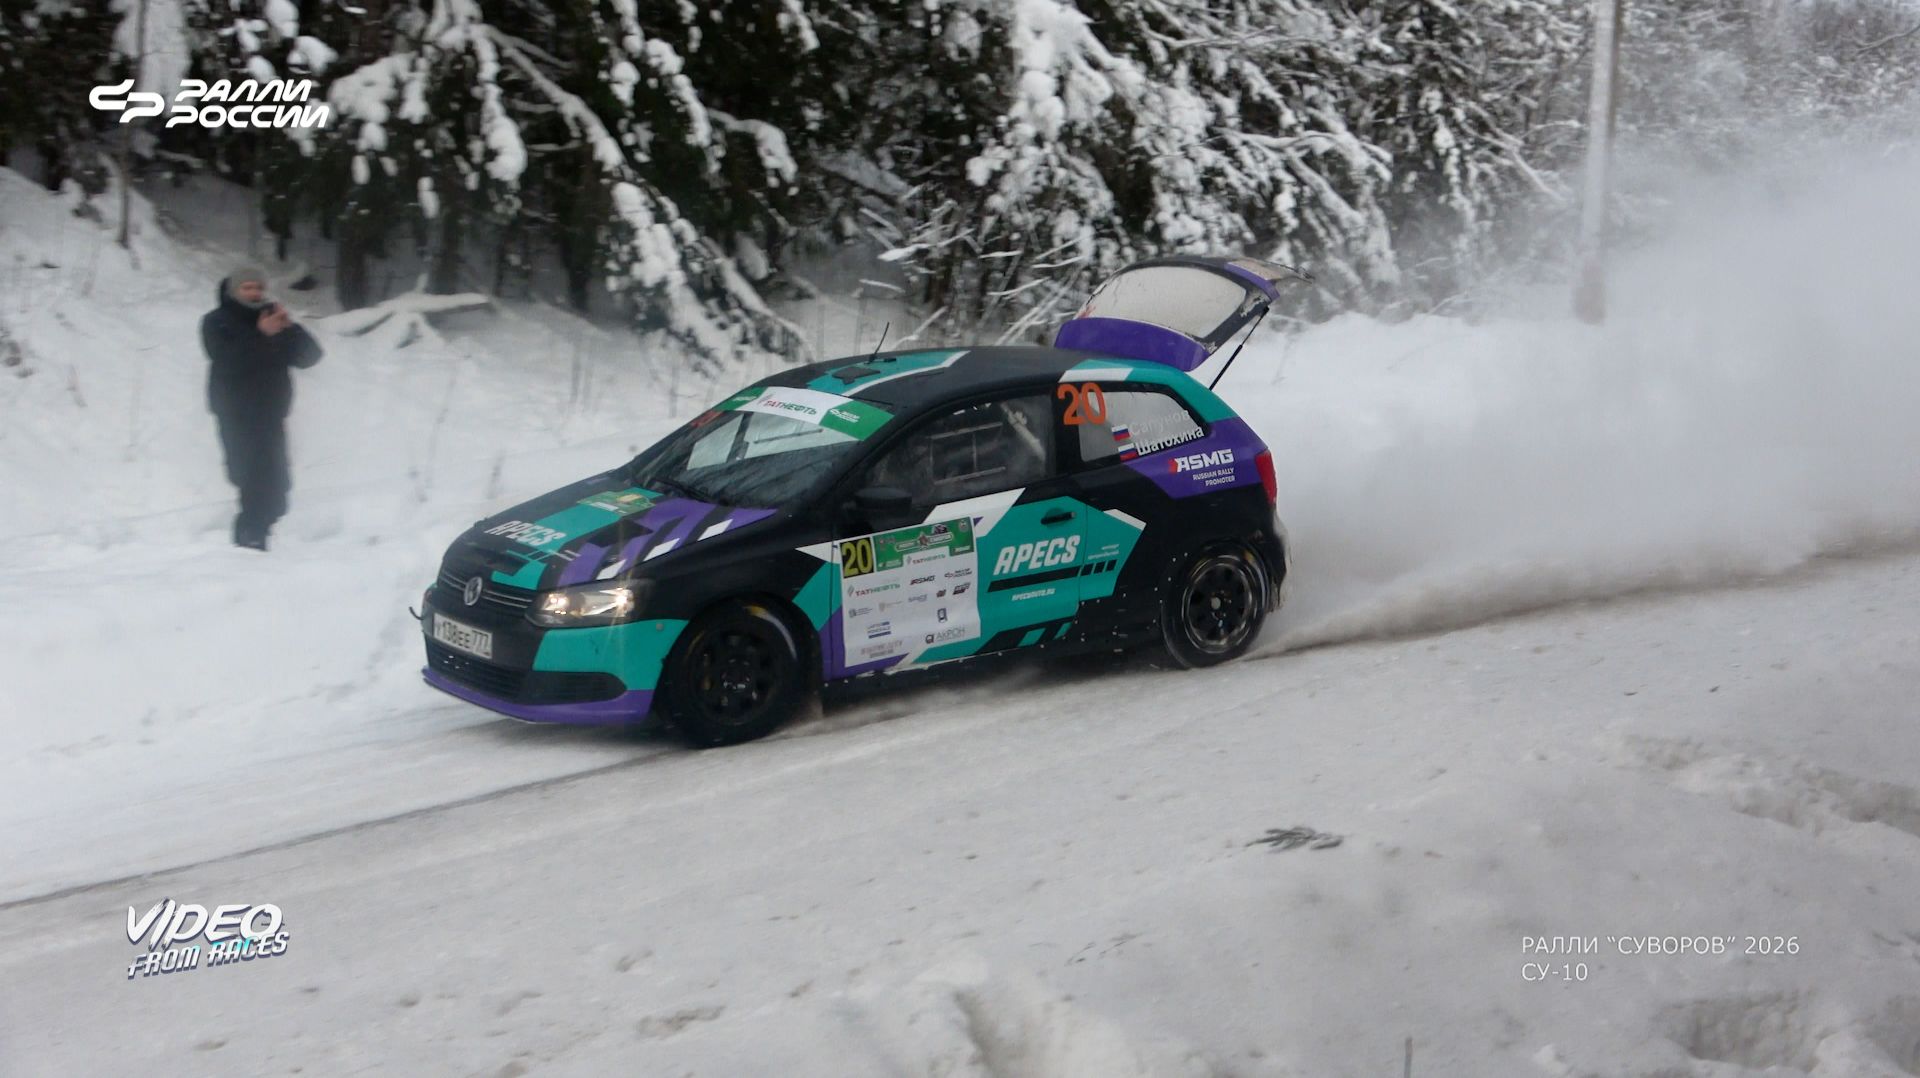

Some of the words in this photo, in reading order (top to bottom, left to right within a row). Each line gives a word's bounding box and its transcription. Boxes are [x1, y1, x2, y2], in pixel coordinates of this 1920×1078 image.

[1056, 382, 1107, 426] 20
[1135, 426, 1205, 456] Шатохина
[1174, 449, 1235, 473] ASMG
[1193, 470, 1218, 481] RUSSIAN
[1217, 467, 1235, 477] RALLY
[484, 520, 567, 547] APECS
[841, 538, 874, 577] 20
[993, 535, 1081, 576] APECS
